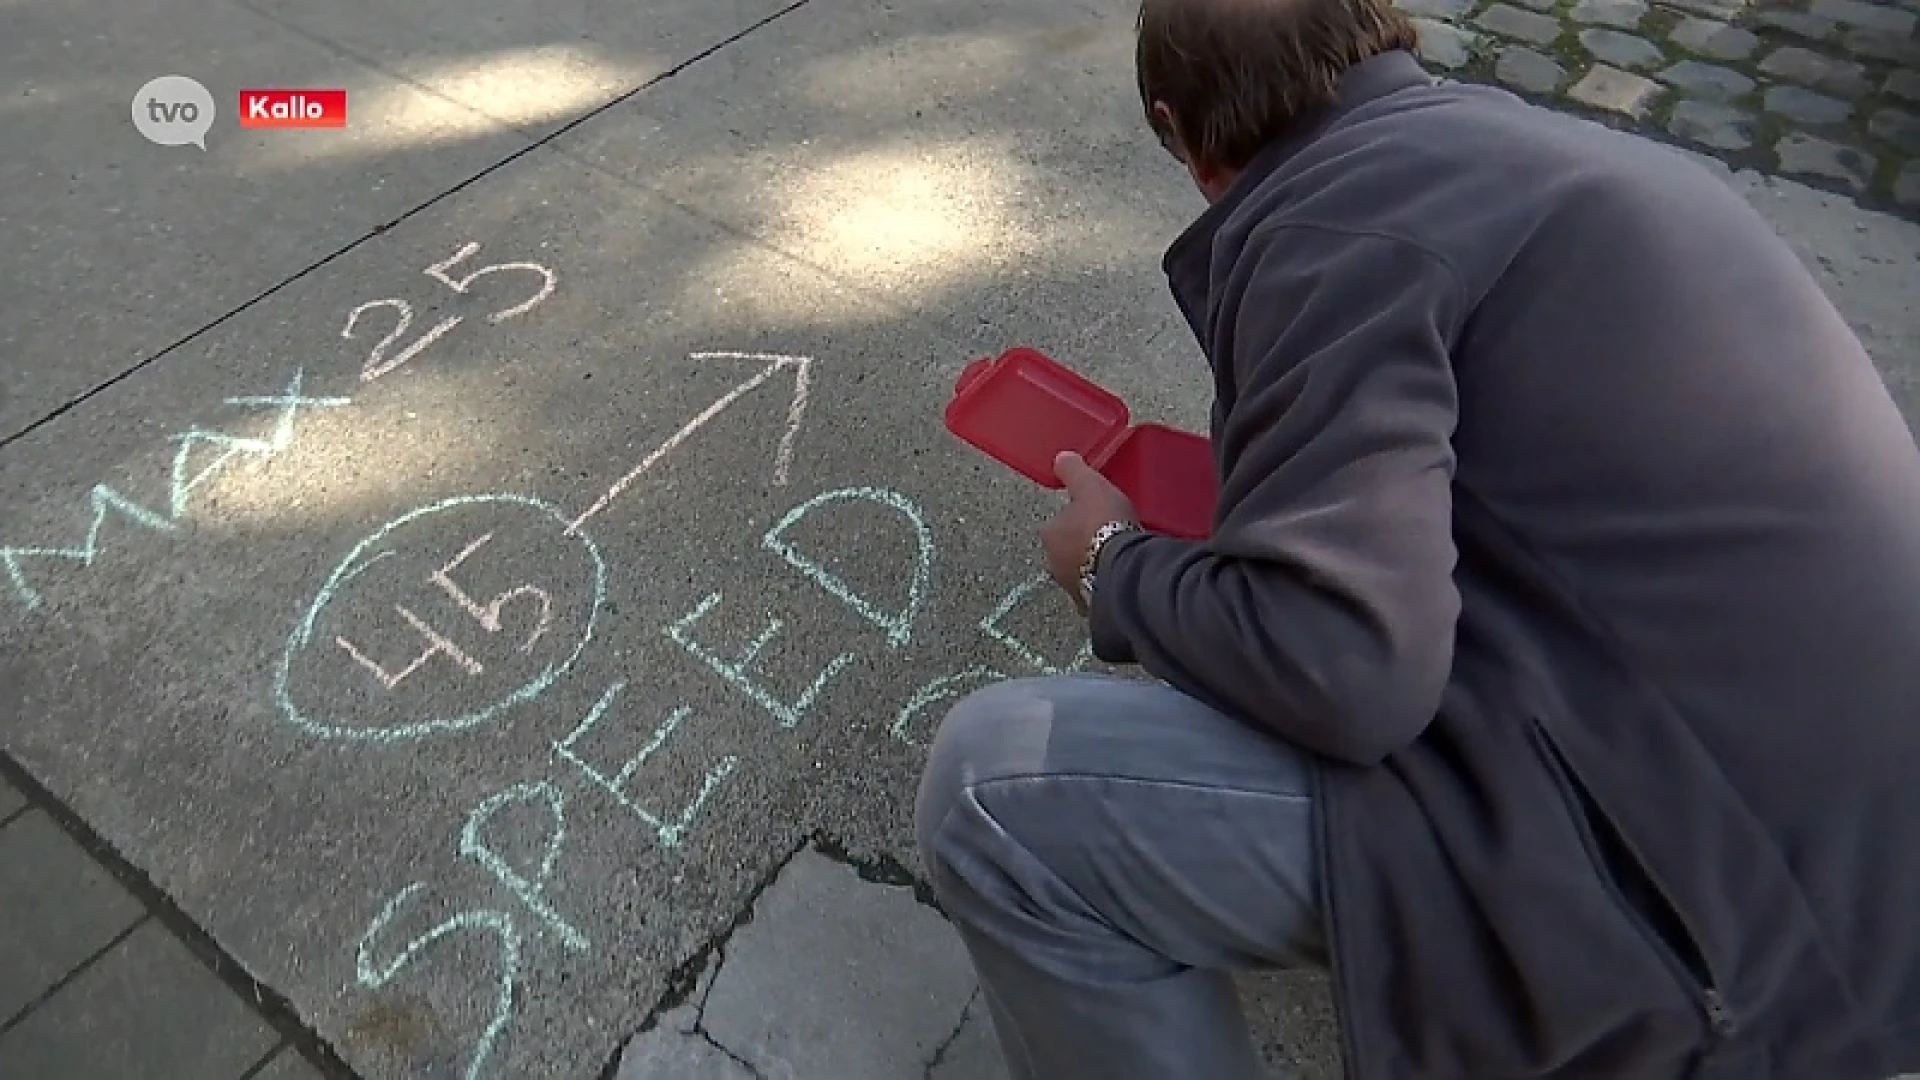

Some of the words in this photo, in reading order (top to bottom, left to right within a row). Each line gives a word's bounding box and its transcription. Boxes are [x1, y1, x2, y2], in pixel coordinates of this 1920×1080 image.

[0, 366, 350, 609] MAX
[340, 241, 557, 382] 25
[335, 530, 551, 689] 45
[356, 486, 934, 1080] SPEED
